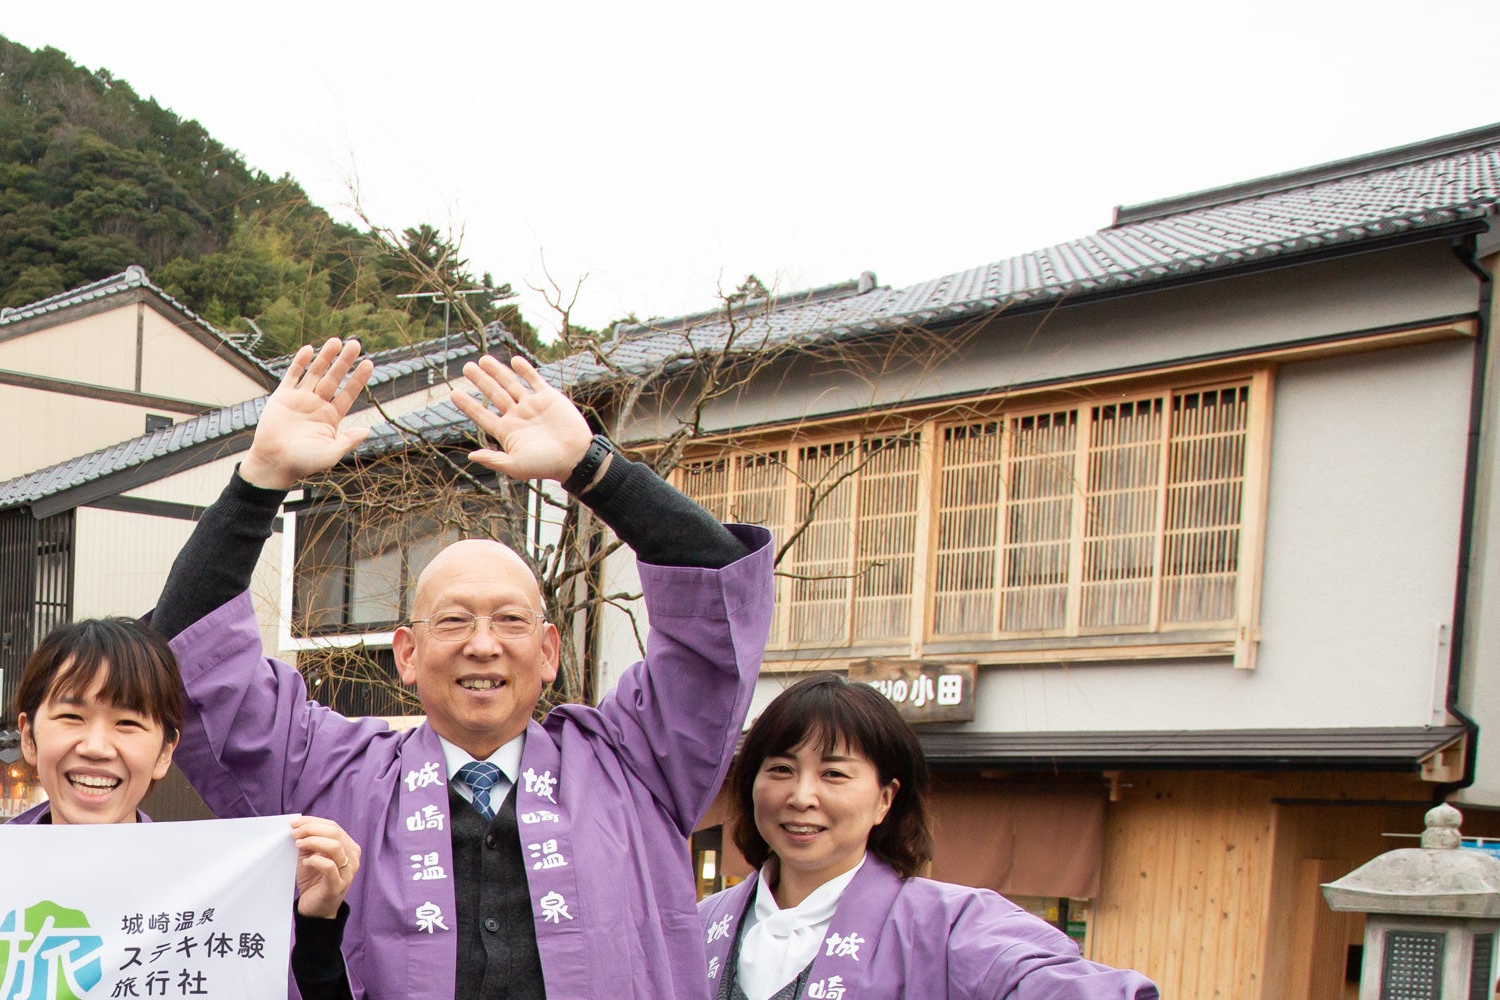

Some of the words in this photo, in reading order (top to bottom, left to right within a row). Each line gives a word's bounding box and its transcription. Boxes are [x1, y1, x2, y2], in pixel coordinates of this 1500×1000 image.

[867, 674, 962, 707] りの小田
[404, 761, 449, 933] 城崎温泉
[521, 767, 574, 924] 城崎温泉
[120, 908, 215, 935] 城崎温泉
[119, 932, 266, 971] ステキ体験
[110, 968, 209, 998] 旅行社
